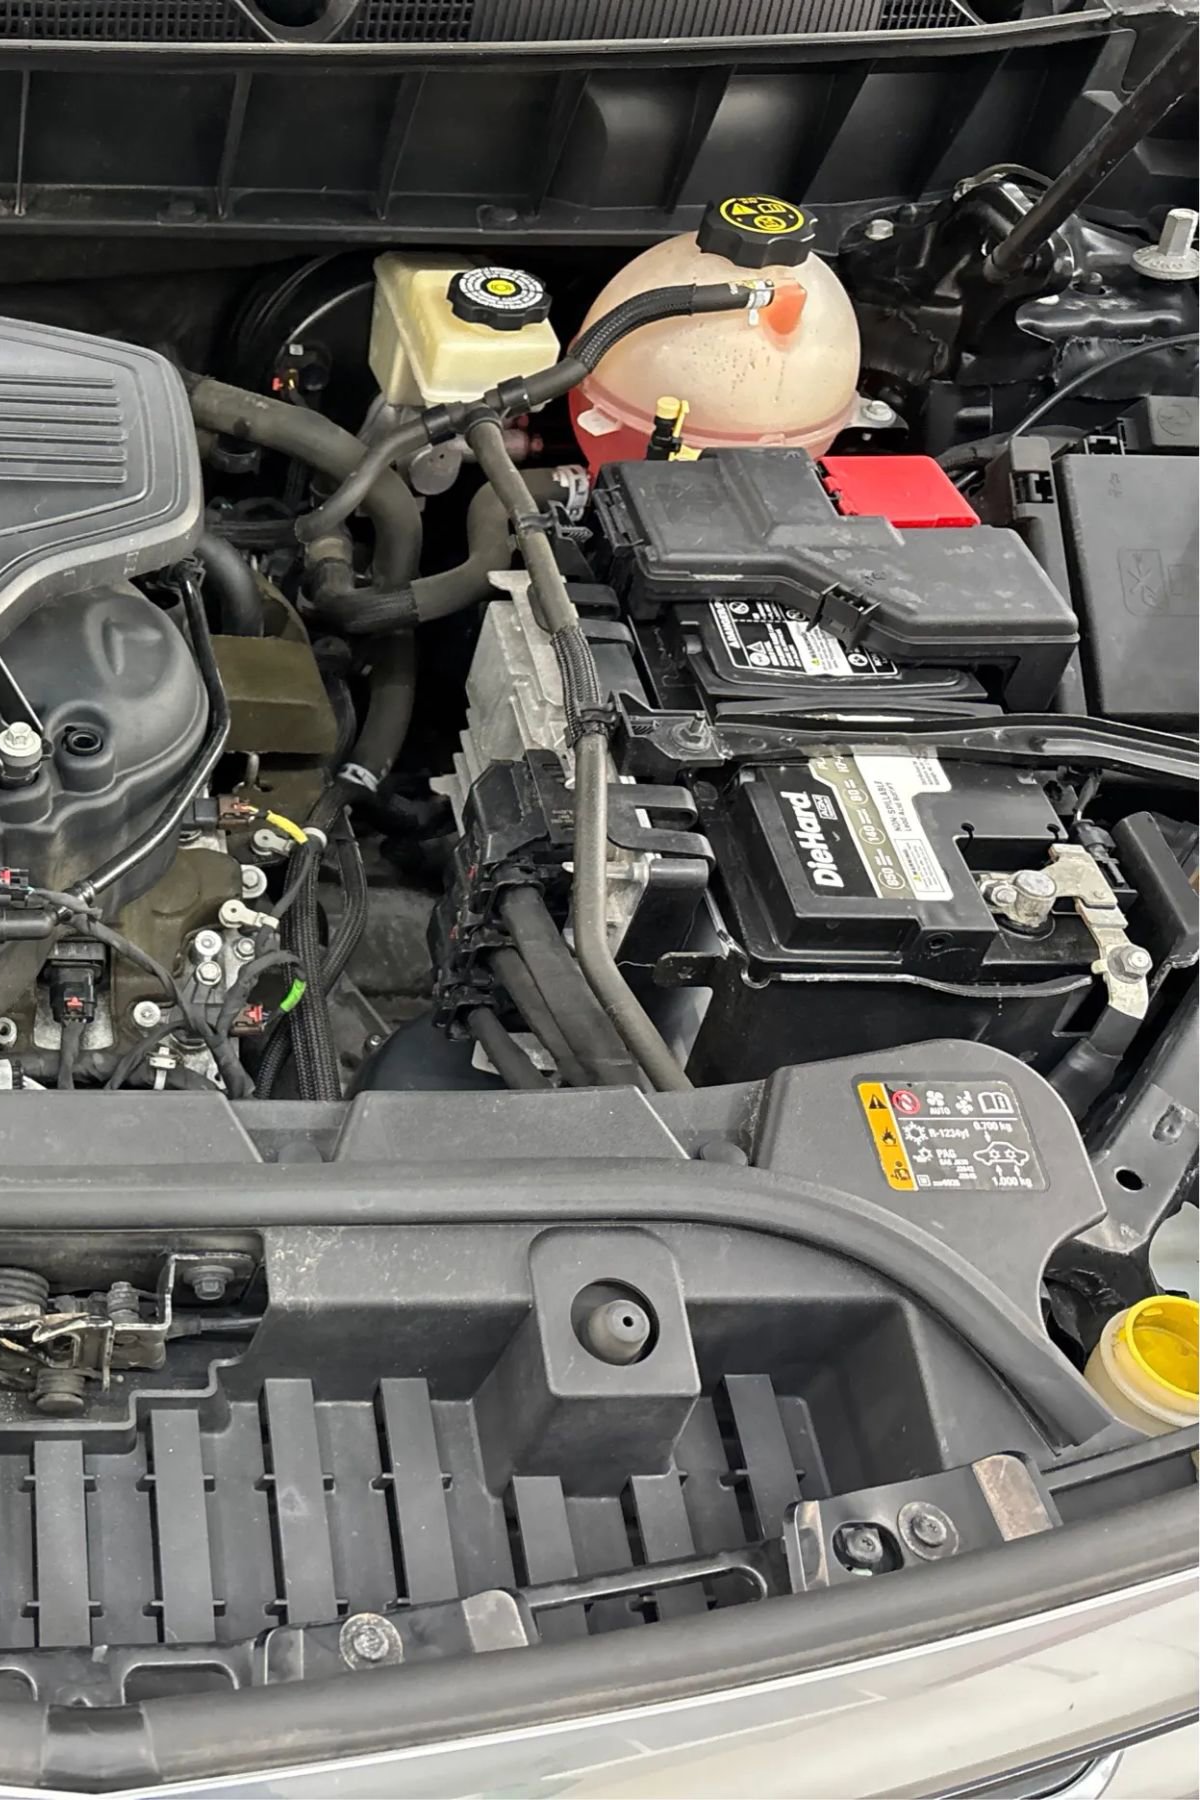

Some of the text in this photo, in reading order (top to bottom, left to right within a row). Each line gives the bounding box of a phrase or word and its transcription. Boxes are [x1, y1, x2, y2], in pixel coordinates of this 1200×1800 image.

[780, 790, 845, 888] DieHard
[863, 825, 880, 842] 140
[929, 1107, 951, 1116] AUTO
[999, 1121, 1014, 1133] kg
[935, 1148, 958, 1159] PAG
